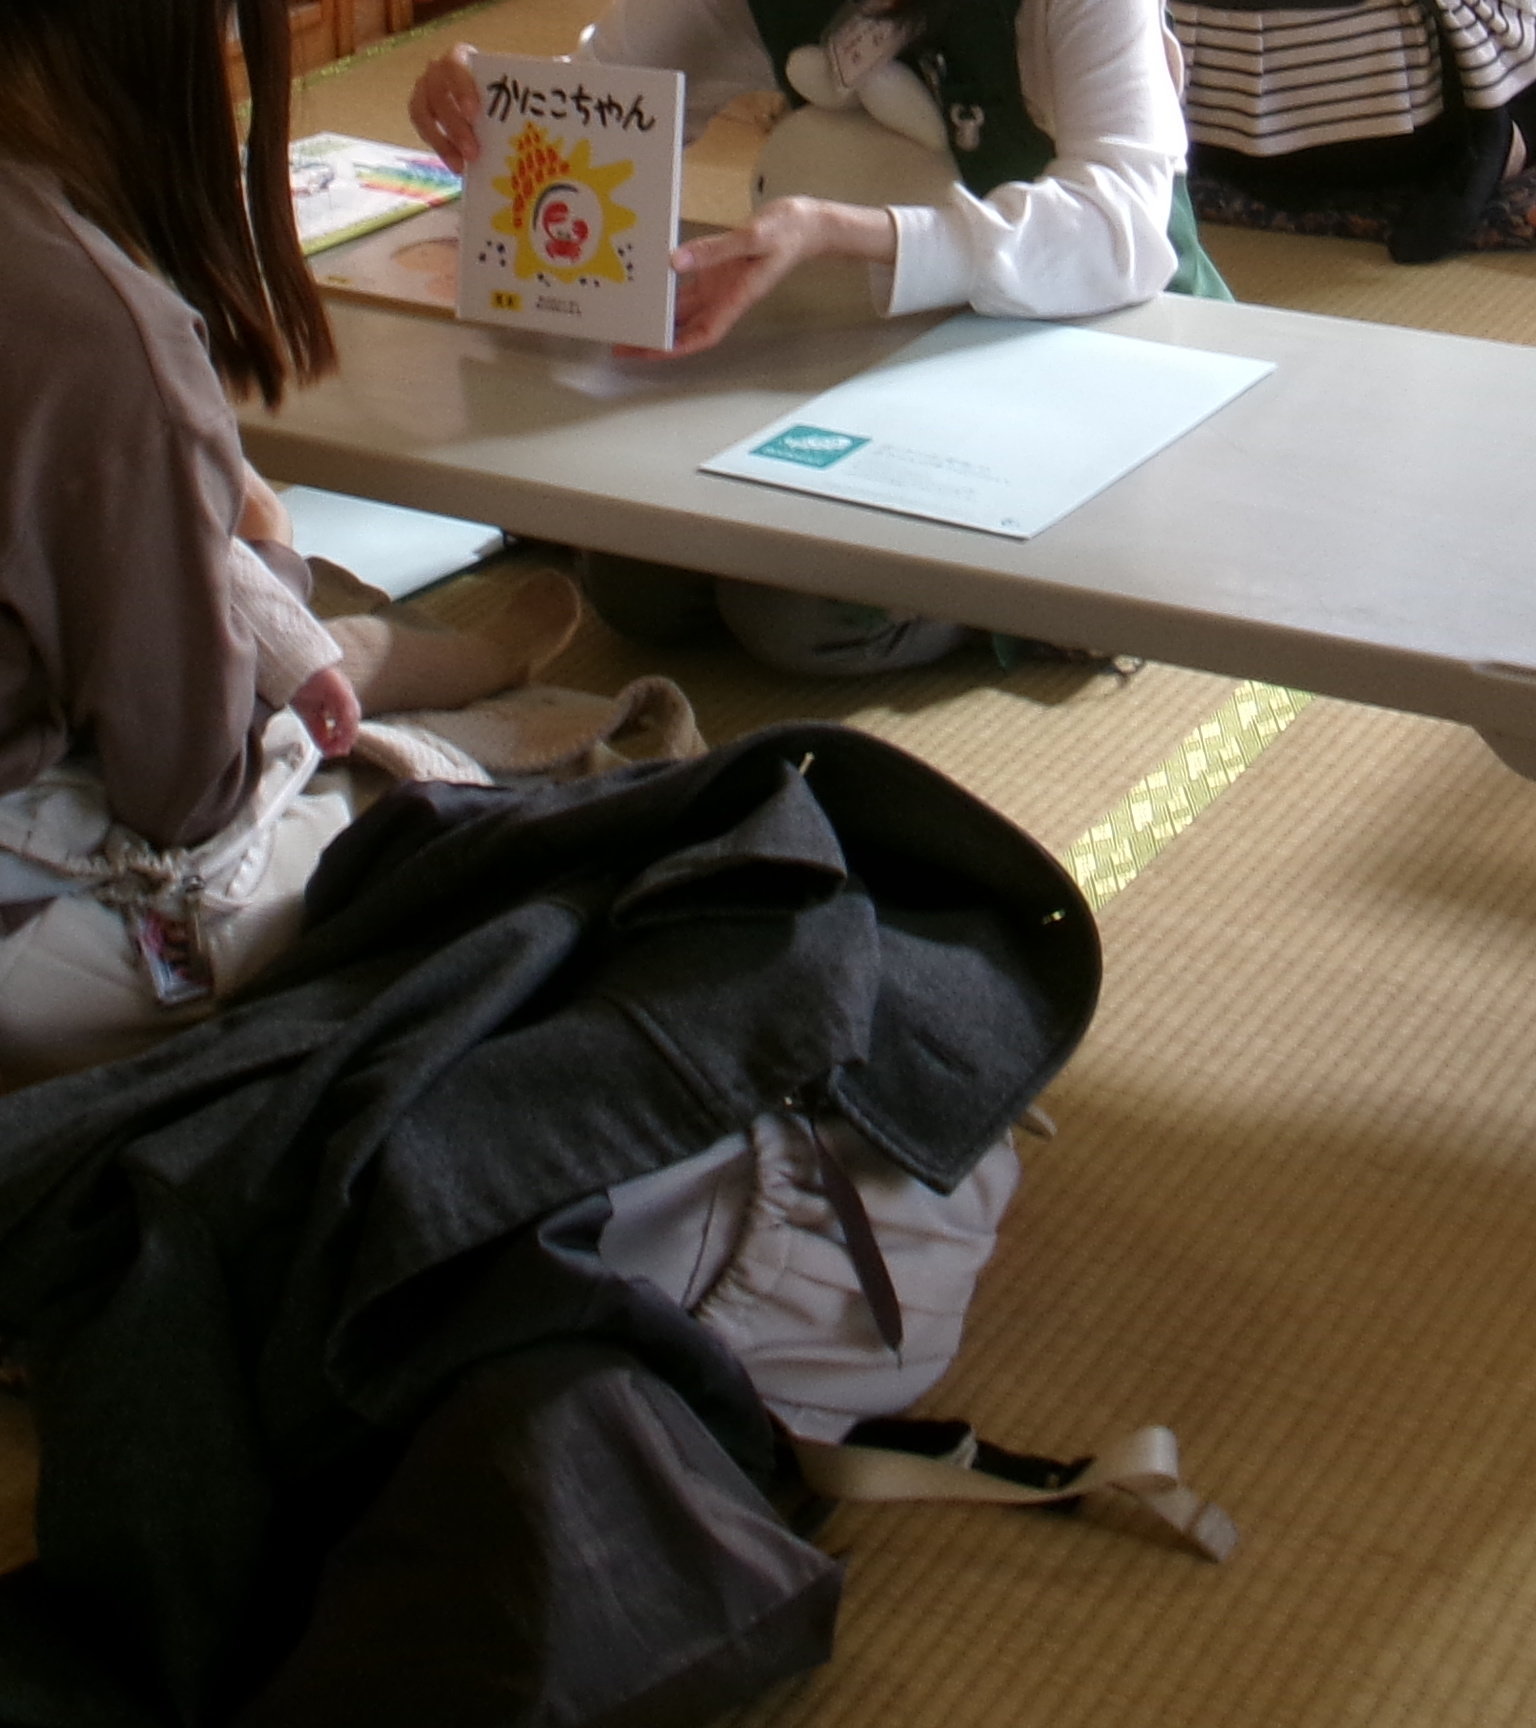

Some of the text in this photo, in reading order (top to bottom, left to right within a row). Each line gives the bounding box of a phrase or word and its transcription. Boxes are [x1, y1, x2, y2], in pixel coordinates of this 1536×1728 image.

[486, 73, 657, 133] かにこちゃん
